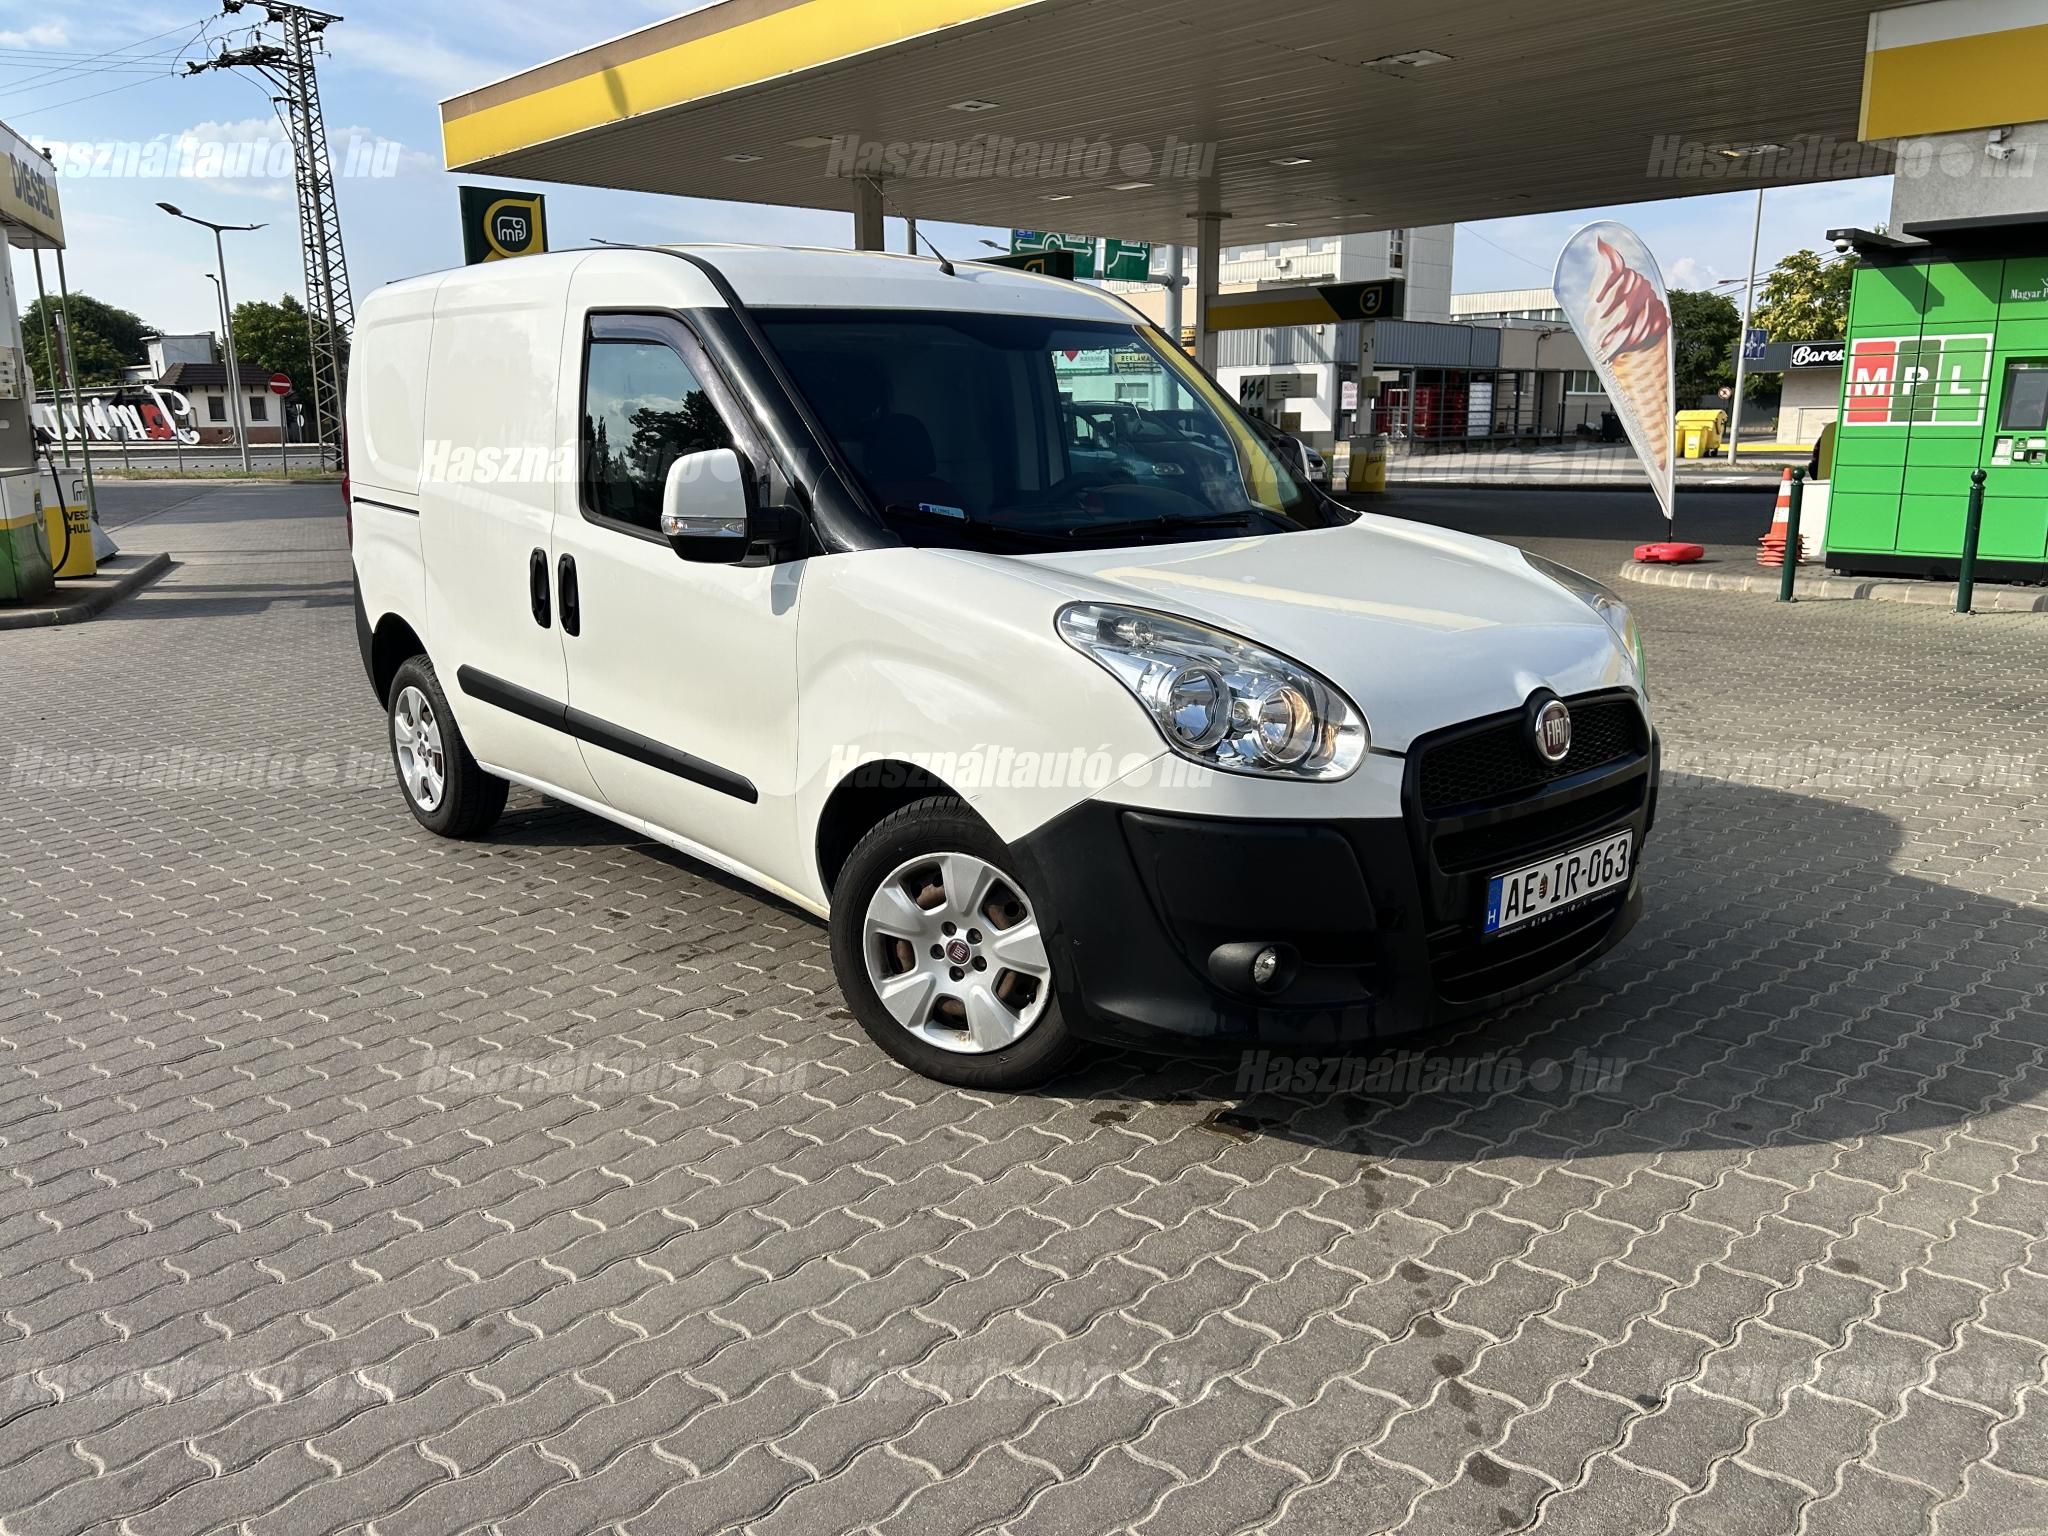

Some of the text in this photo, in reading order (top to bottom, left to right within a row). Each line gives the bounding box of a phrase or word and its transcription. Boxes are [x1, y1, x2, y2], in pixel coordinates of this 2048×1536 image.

[10, 152, 55, 220] DIESEL
[1367, 292, 1376, 307] 2
[2011, 289, 2041, 301] Magyar
[1546, 717, 1565, 747] FIAT
[1487, 909, 1497, 925] H
